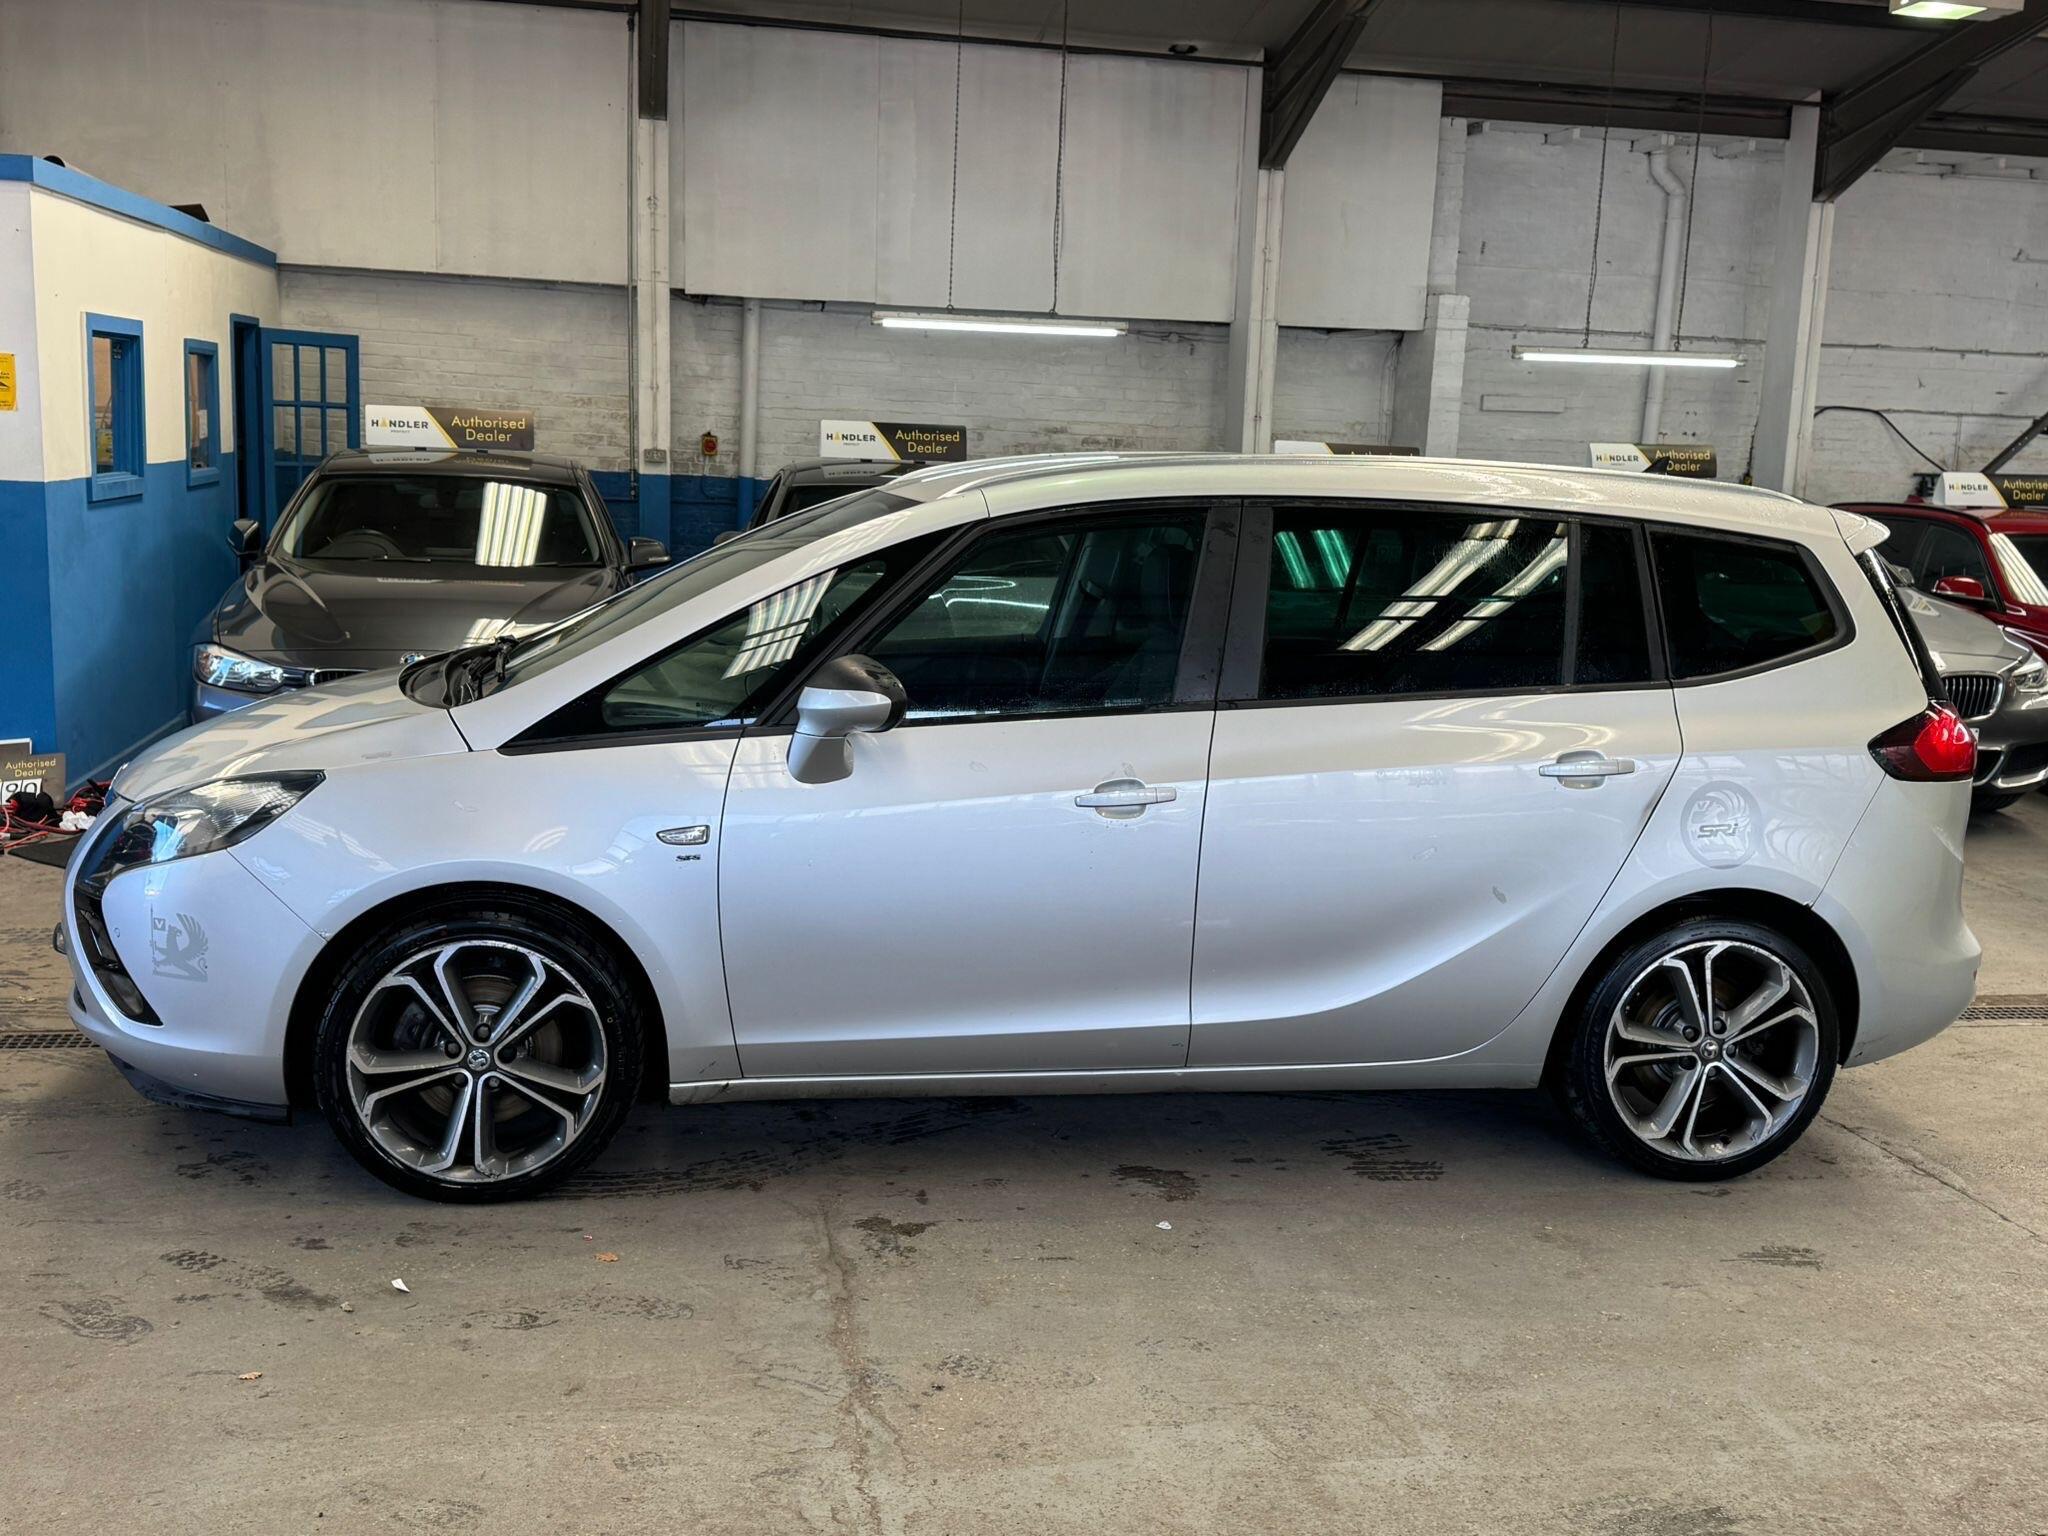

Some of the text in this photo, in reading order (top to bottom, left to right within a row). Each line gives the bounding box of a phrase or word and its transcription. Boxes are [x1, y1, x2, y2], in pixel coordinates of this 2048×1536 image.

[451, 415, 526, 430] Authorised
[466, 428, 512, 442] Dealer
[895, 430, 961, 442] Authorised
[907, 441, 948, 454] Dealer
[2013, 489, 2046, 500] Dealer
[5, 758, 57, 770] Authorised
[14, 768, 48, 778] Dealer
[1697, 823, 1739, 839] SRi
